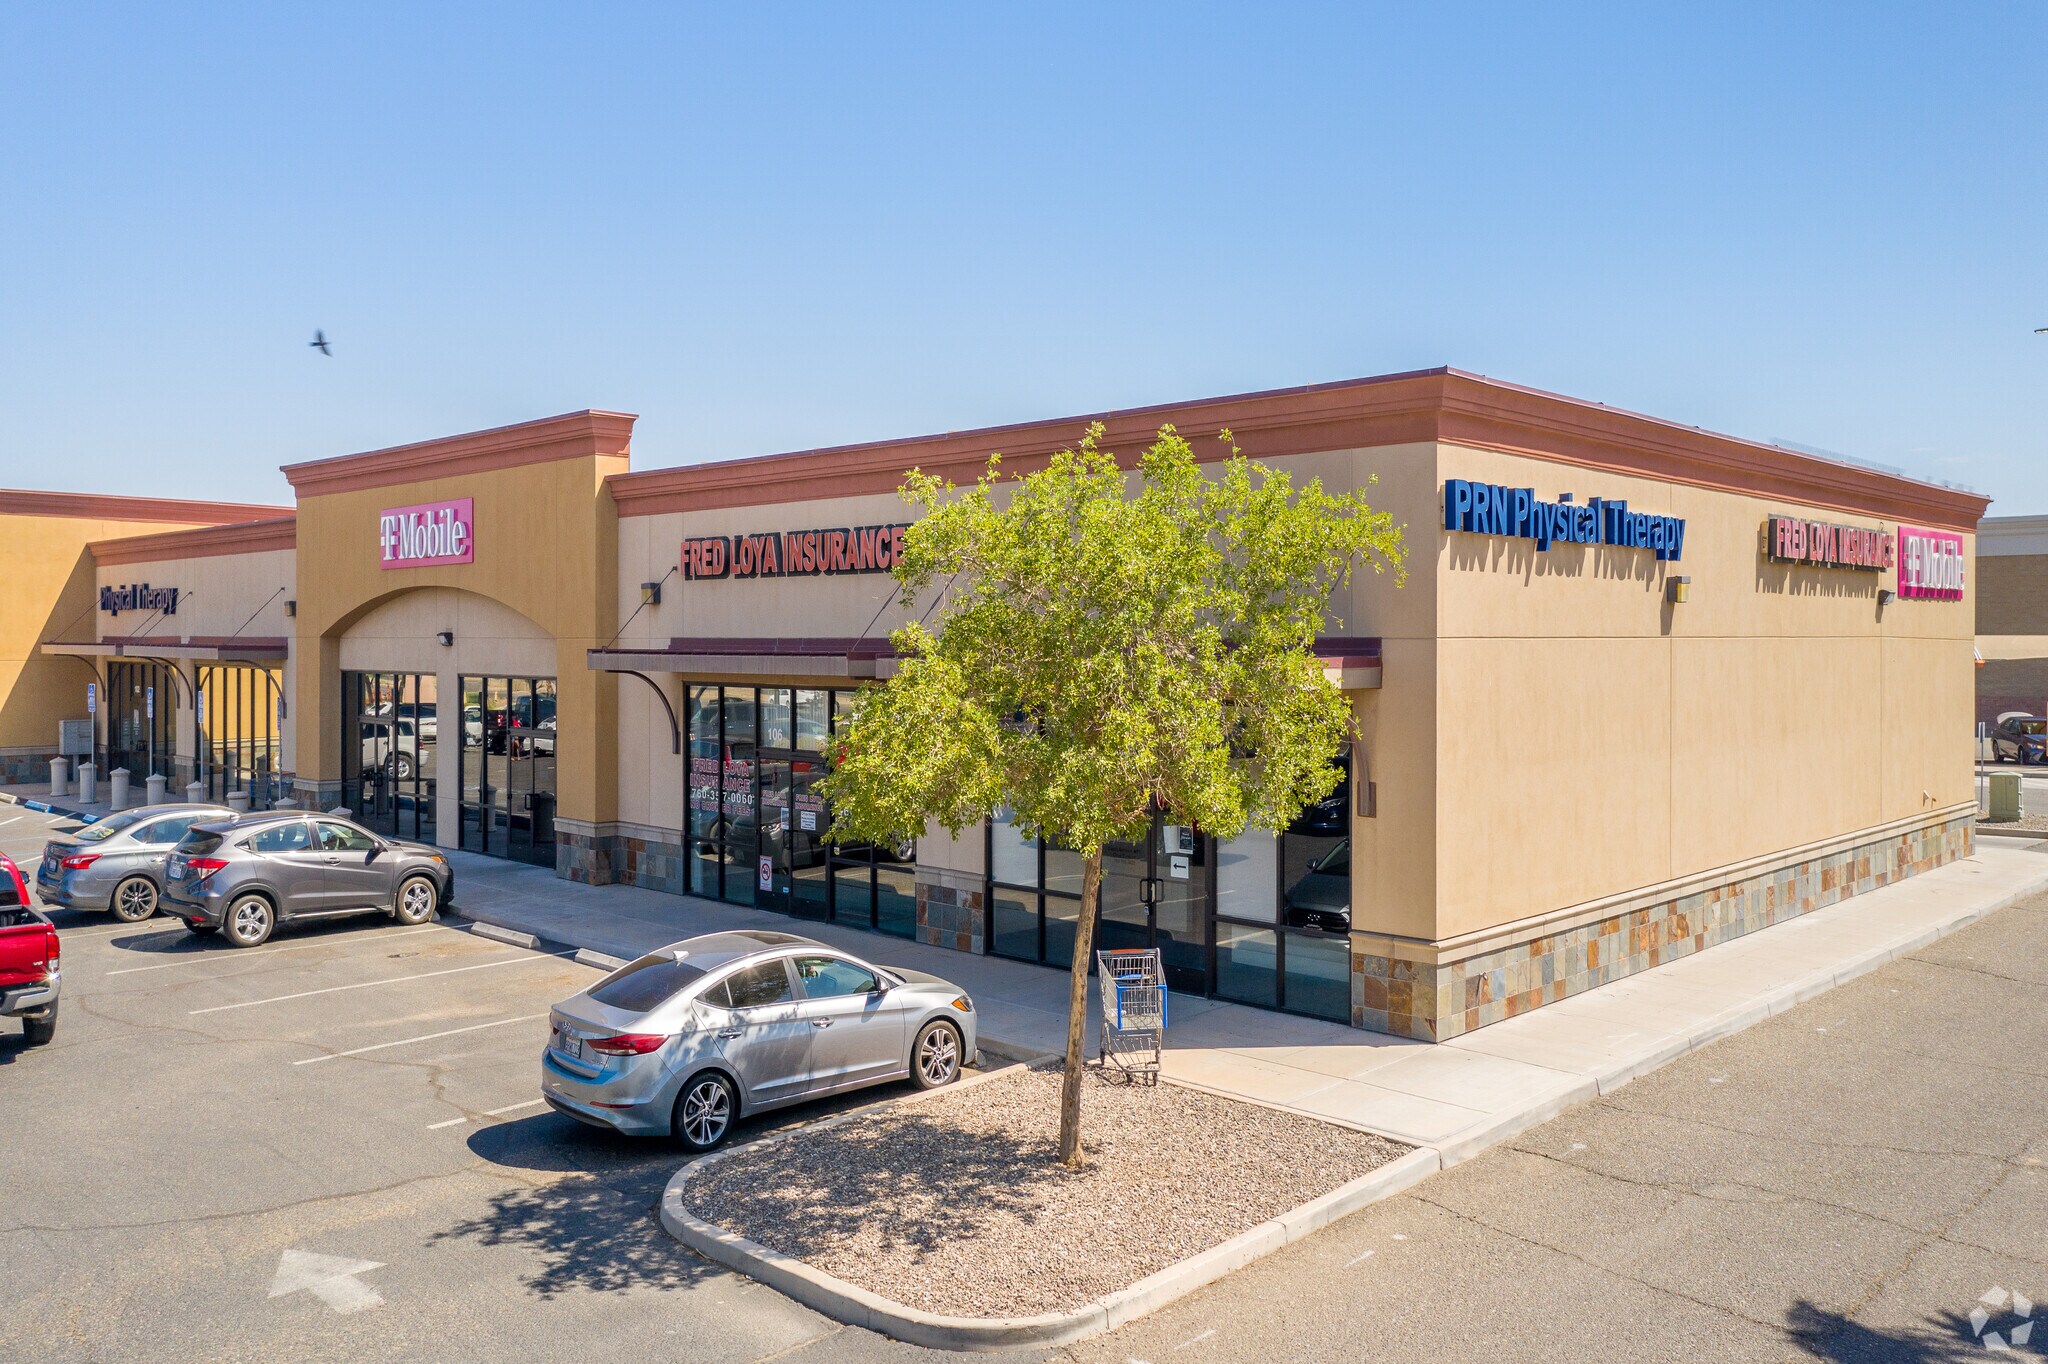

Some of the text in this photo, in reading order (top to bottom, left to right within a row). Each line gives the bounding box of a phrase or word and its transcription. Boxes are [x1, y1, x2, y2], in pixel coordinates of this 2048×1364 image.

[1448, 479, 1686, 561] PRN Physical Therapy
[681, 526, 906, 578] FRED LOYA INSURANCE
[1773, 518, 1895, 569] FRED LOYA INSURANCE
[101, 583, 178, 616] Physical Therapy
[768, 728, 783, 741] 106
[692, 757, 750, 777] FRED LOYA
